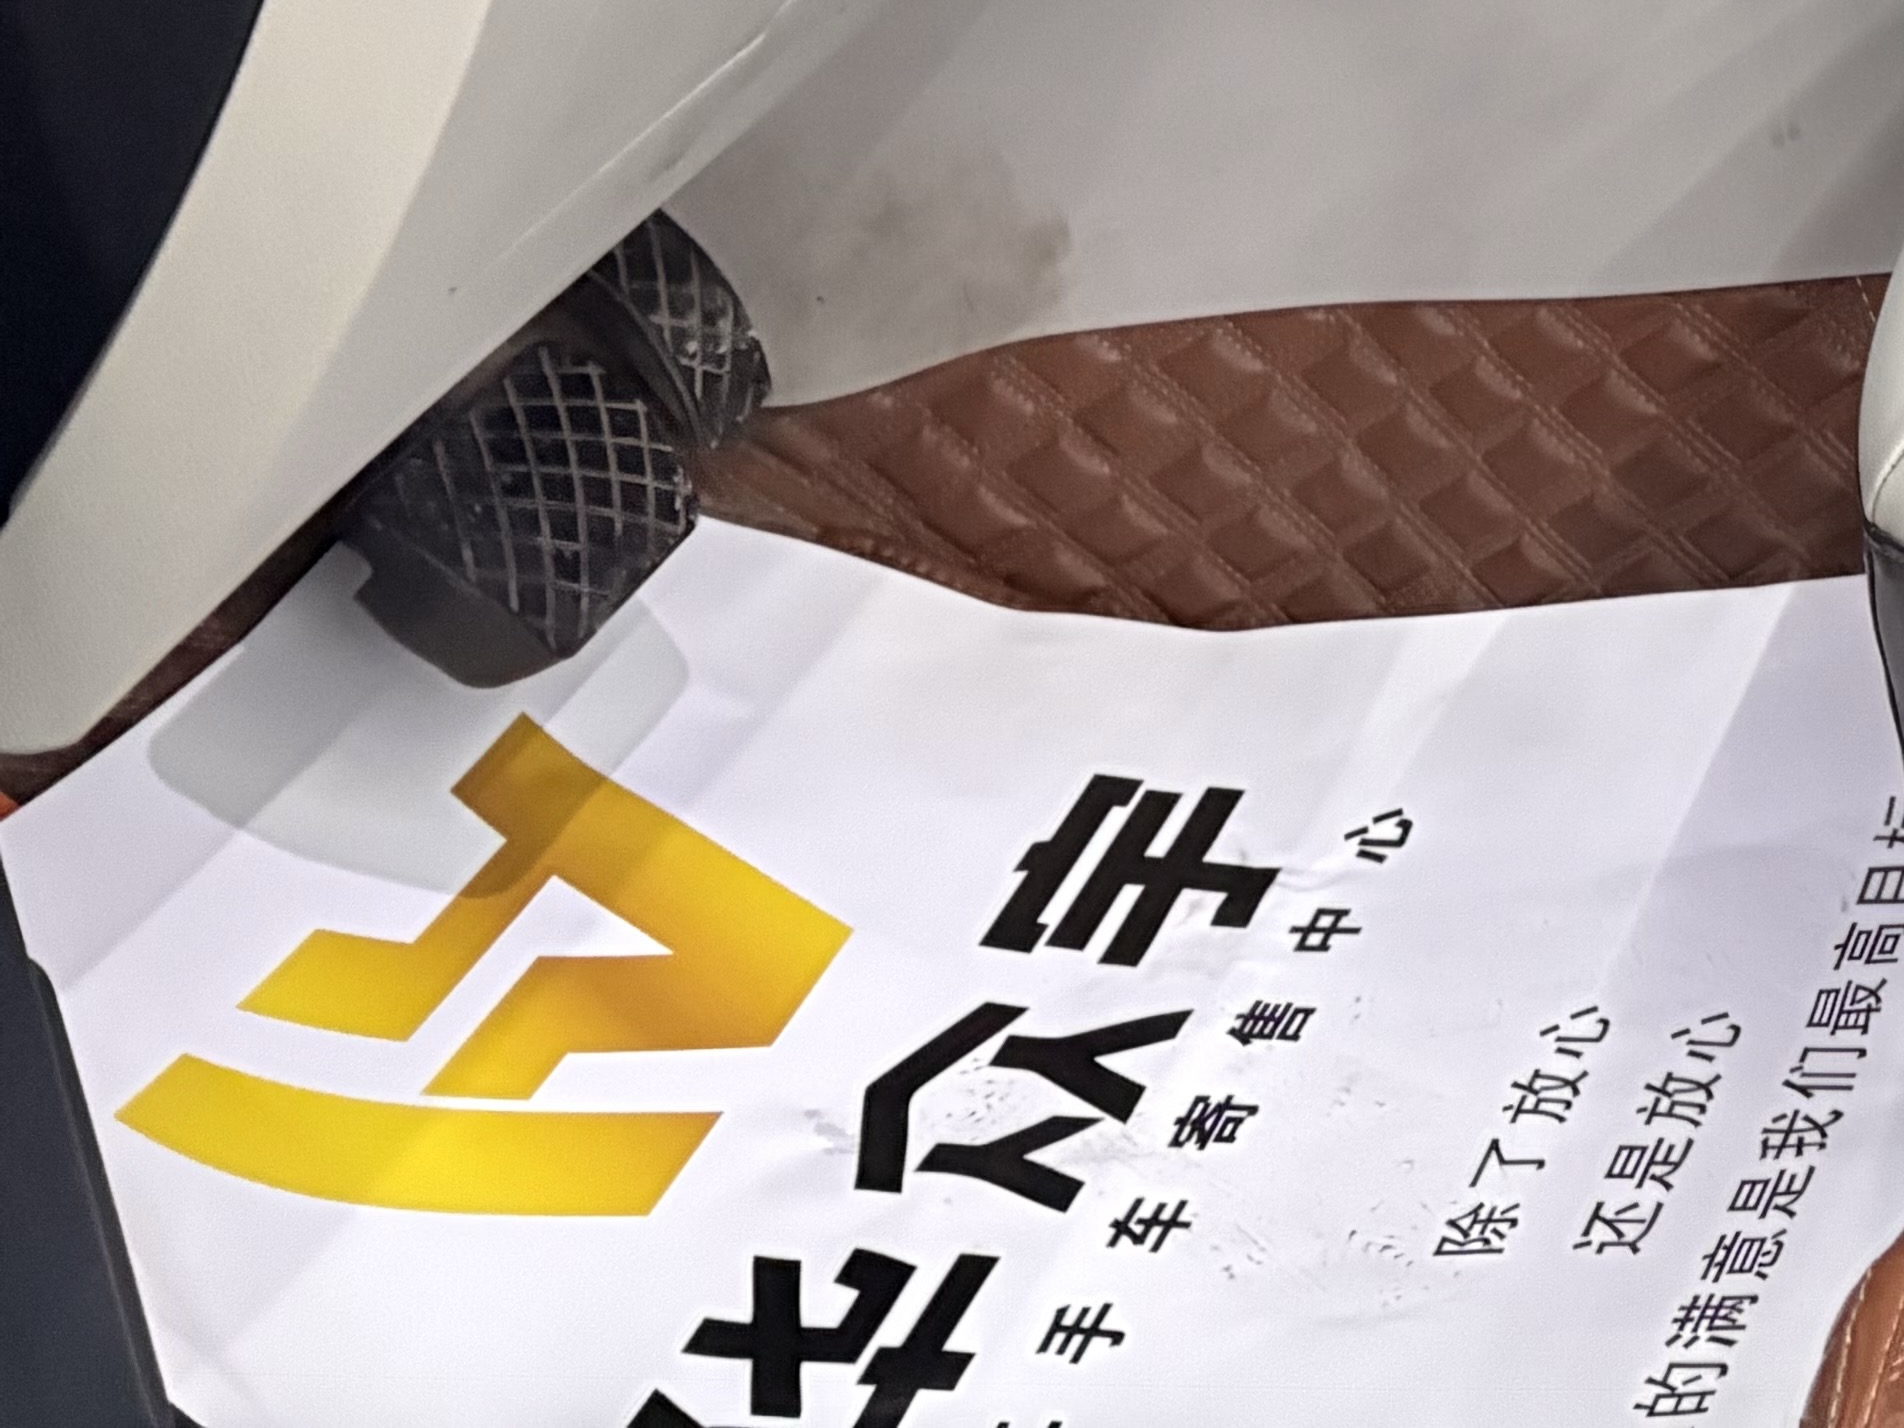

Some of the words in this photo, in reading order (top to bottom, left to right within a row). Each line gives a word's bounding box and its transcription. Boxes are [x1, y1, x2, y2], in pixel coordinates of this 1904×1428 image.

[627, 774, 1282, 1428] 华众宇
[995, 808, 1415, 1428] 手车寄售中心
[1433, 1006, 1610, 1256] 除了放心
[1572, 1011, 1741, 1256] 还是放心
